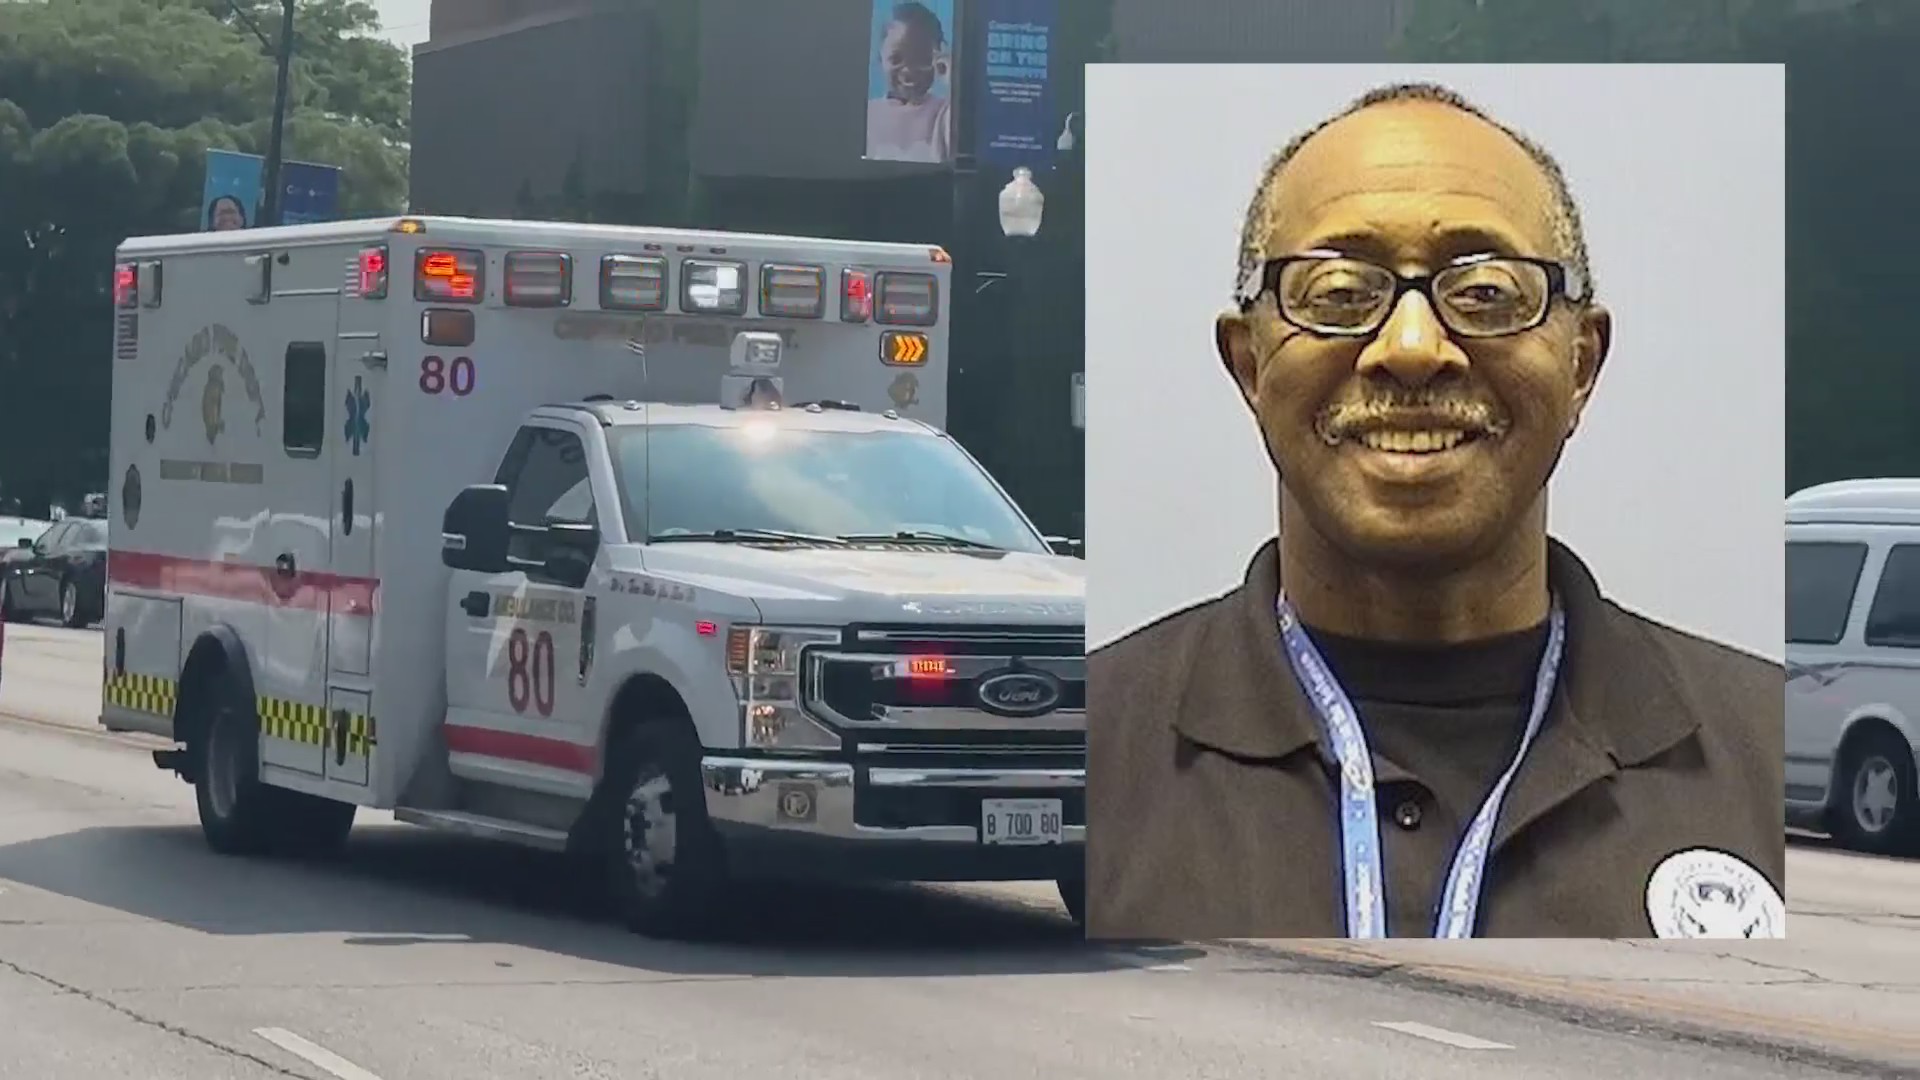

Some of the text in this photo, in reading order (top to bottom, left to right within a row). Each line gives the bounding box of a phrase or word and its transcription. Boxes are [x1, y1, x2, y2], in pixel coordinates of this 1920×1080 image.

[988, 32, 1047, 50] BRING
[419, 356, 475, 396] 80
[508, 627, 555, 717] 80
[1006, 813, 1032, 835] 700
